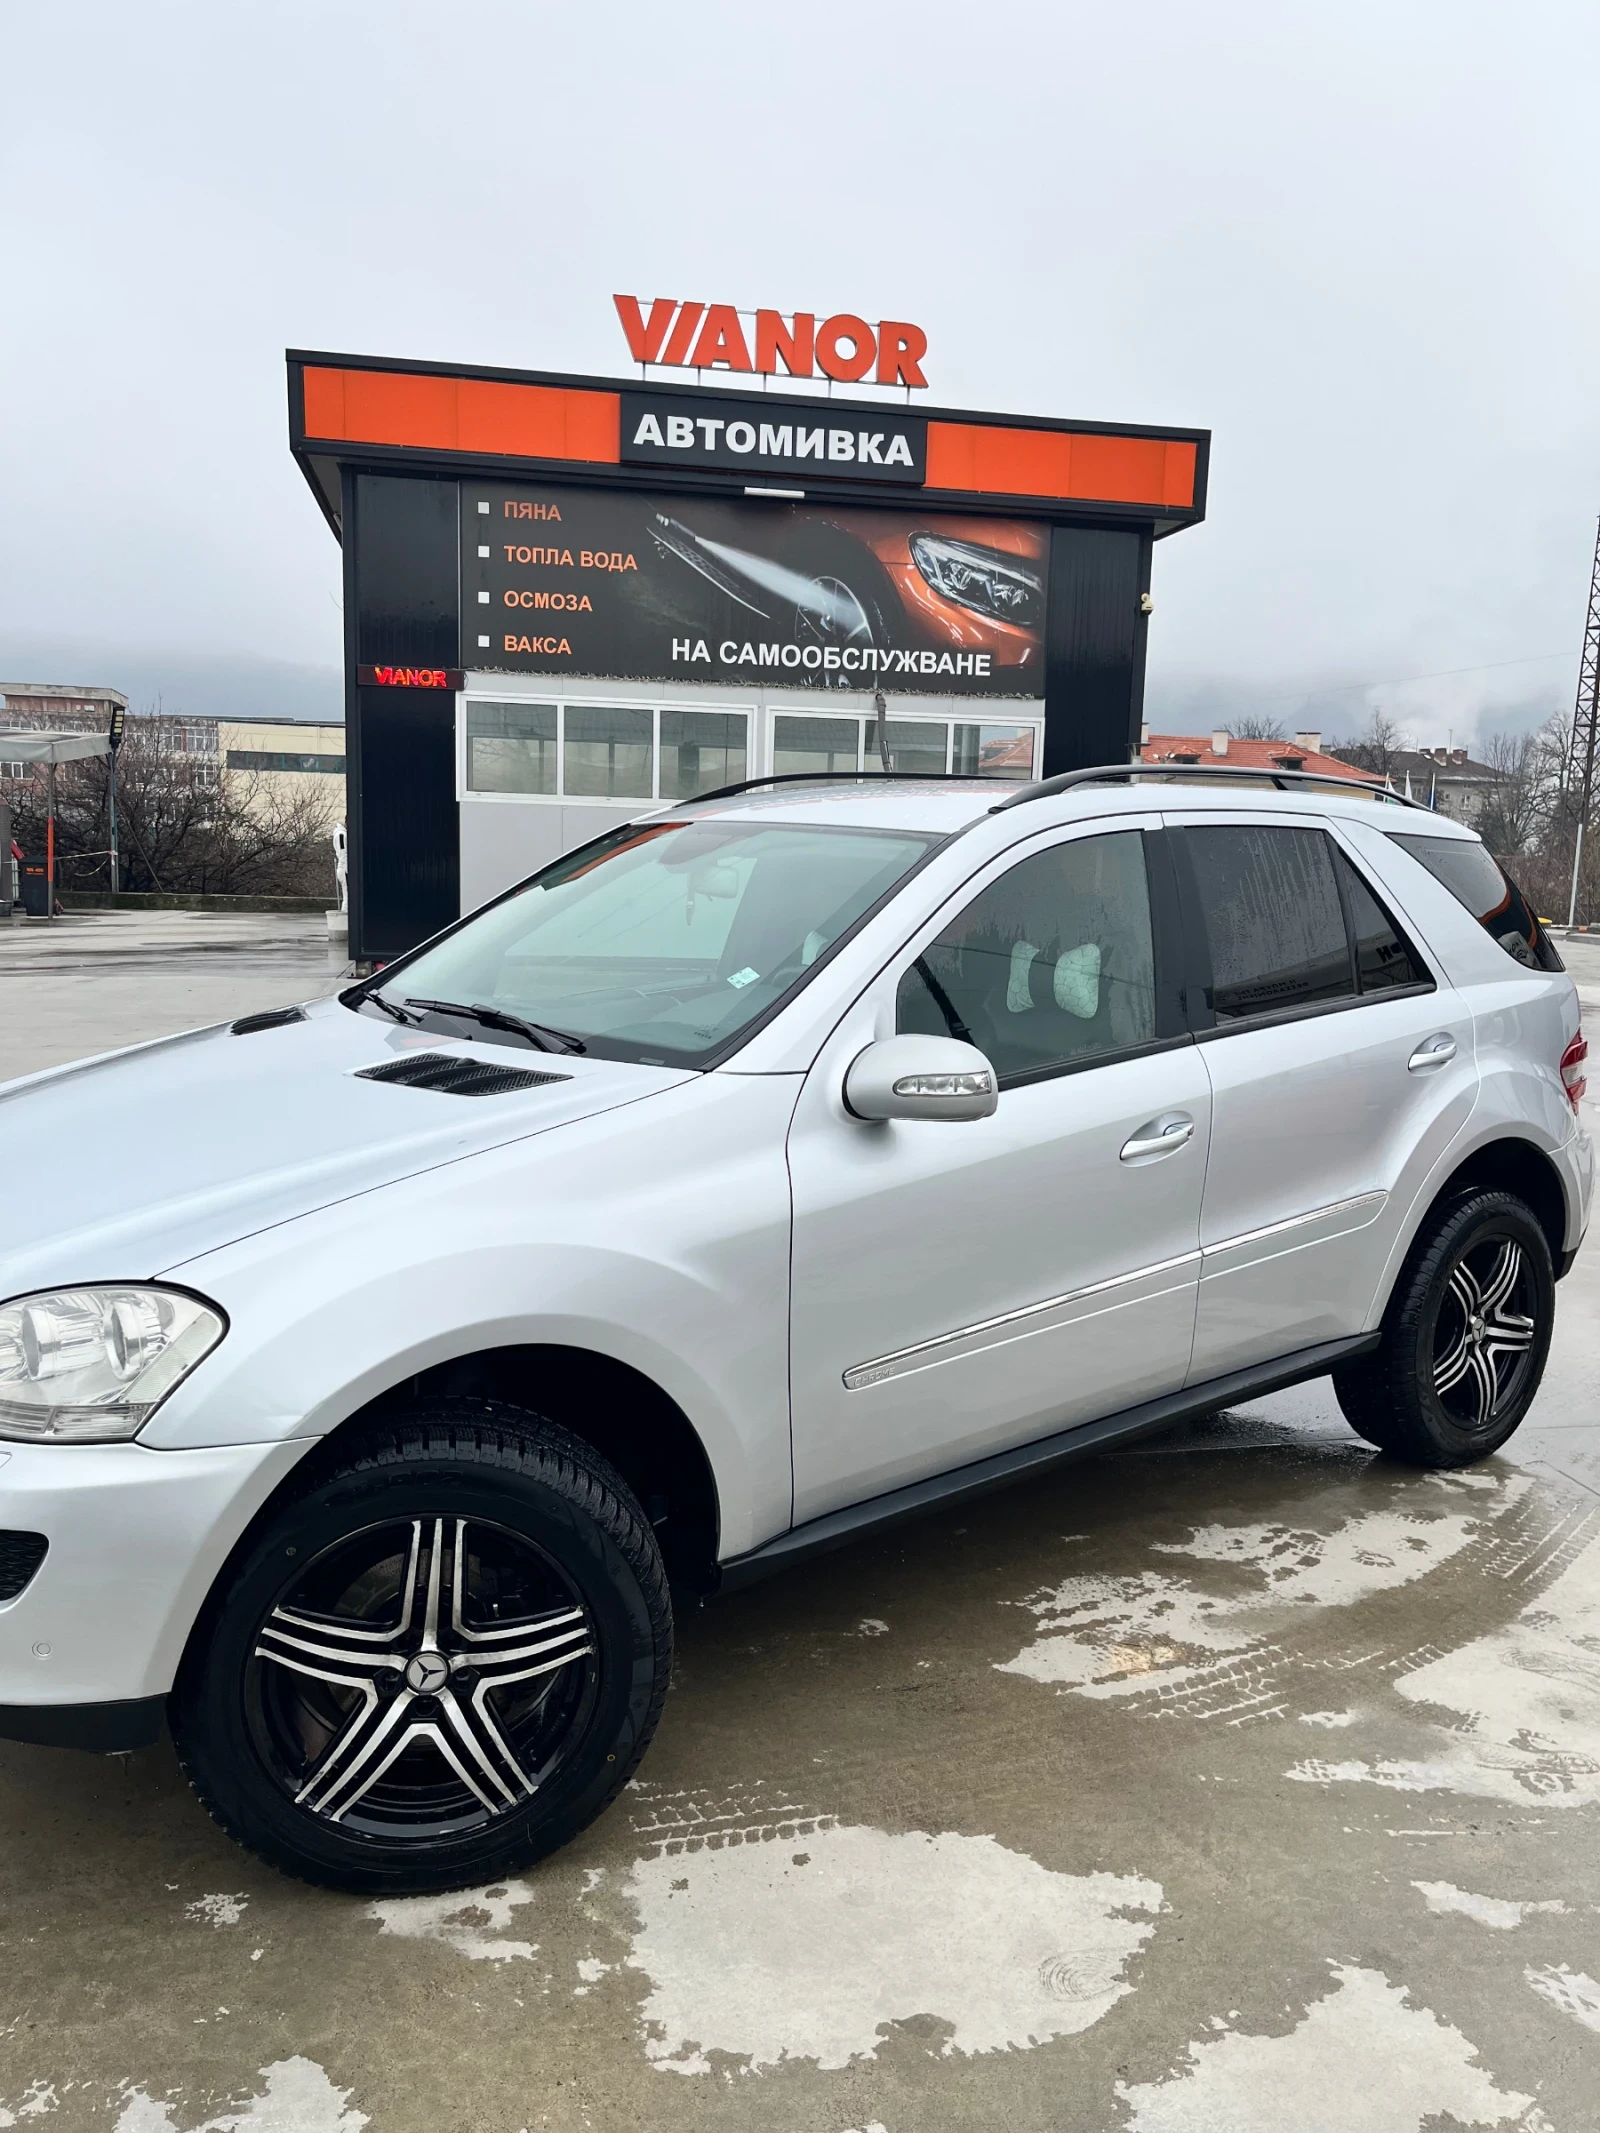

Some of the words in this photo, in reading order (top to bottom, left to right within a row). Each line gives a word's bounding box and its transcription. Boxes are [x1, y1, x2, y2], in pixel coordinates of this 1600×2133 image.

[612, 293, 929, 389] VIANOR
[633, 413, 915, 467] АВТОМИВКА
[504, 500, 562, 521] ПЯНА
[503, 545, 575, 566] ТОПЛА
[580, 550, 638, 573] ВОДА
[503, 590, 593, 612] ОСМОЗА
[504, 634, 572, 655] ВАКСА
[672, 638, 711, 663] НА
[719, 641, 991, 676] САМООБСЛУЖВАНЕ
[374, 666, 447, 688] VIANOR
